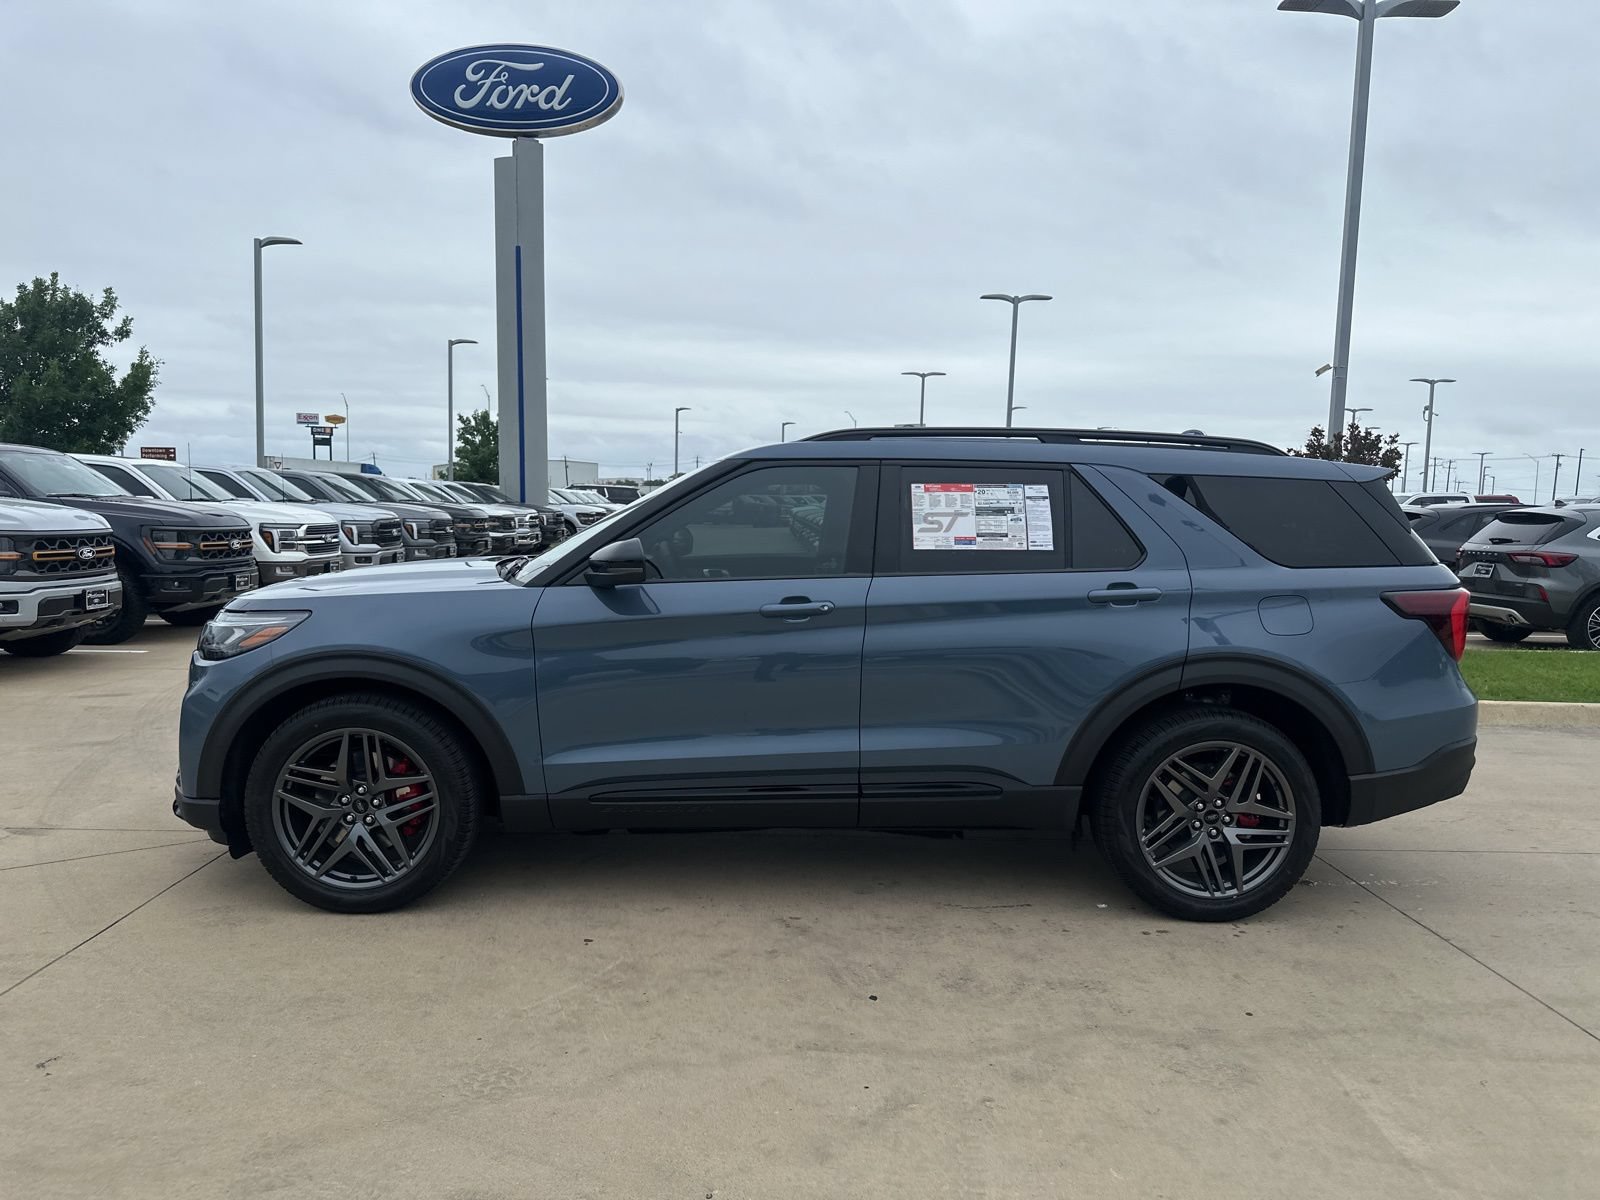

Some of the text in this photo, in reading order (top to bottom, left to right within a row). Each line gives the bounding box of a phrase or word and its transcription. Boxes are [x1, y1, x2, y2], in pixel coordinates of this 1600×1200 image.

[454, 59, 575, 111] Ford
[298, 413, 318, 421] Exxon
[917, 511, 970, 533] ST
